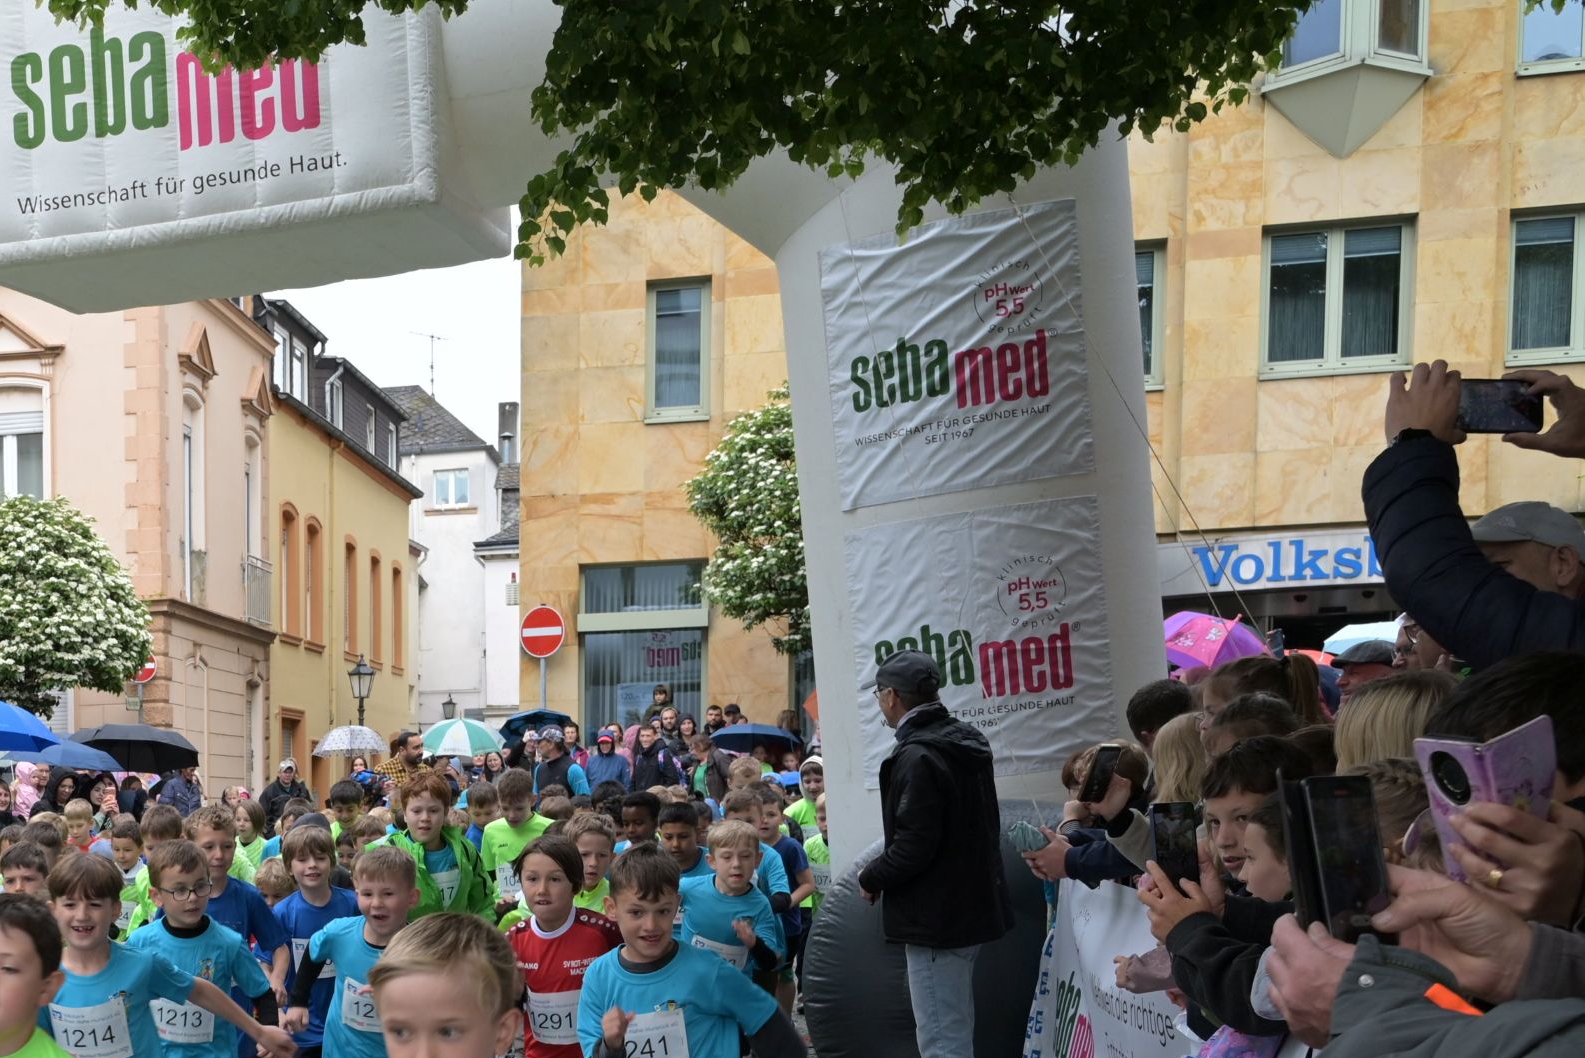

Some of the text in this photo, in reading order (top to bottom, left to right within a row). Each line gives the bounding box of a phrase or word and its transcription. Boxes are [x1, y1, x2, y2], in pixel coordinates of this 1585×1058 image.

[17, 151, 348, 215] Wissenschaft für gesunde Haut.
[995, 296, 1025, 319] 5,5
[987, 307, 1045, 336] geprüft
[855, 404, 1052, 447] WISSENSCHAFT FÜR GESUNDE HAUT
[924, 428, 975, 445] SEIT 1967
[997, 555, 1054, 581] klinisch
[1018, 591, 1048, 612] 5,5
[1011, 602, 1066, 630] geprüft
[962, 695, 1076, 718] FÜR GESUNDE HAUT
[157, 1007, 203, 1028] 1213
[530, 1011, 573, 1030] 1291
[1129, 997, 1176, 1047] richtige
[62, 1025, 116, 1048] 1214
